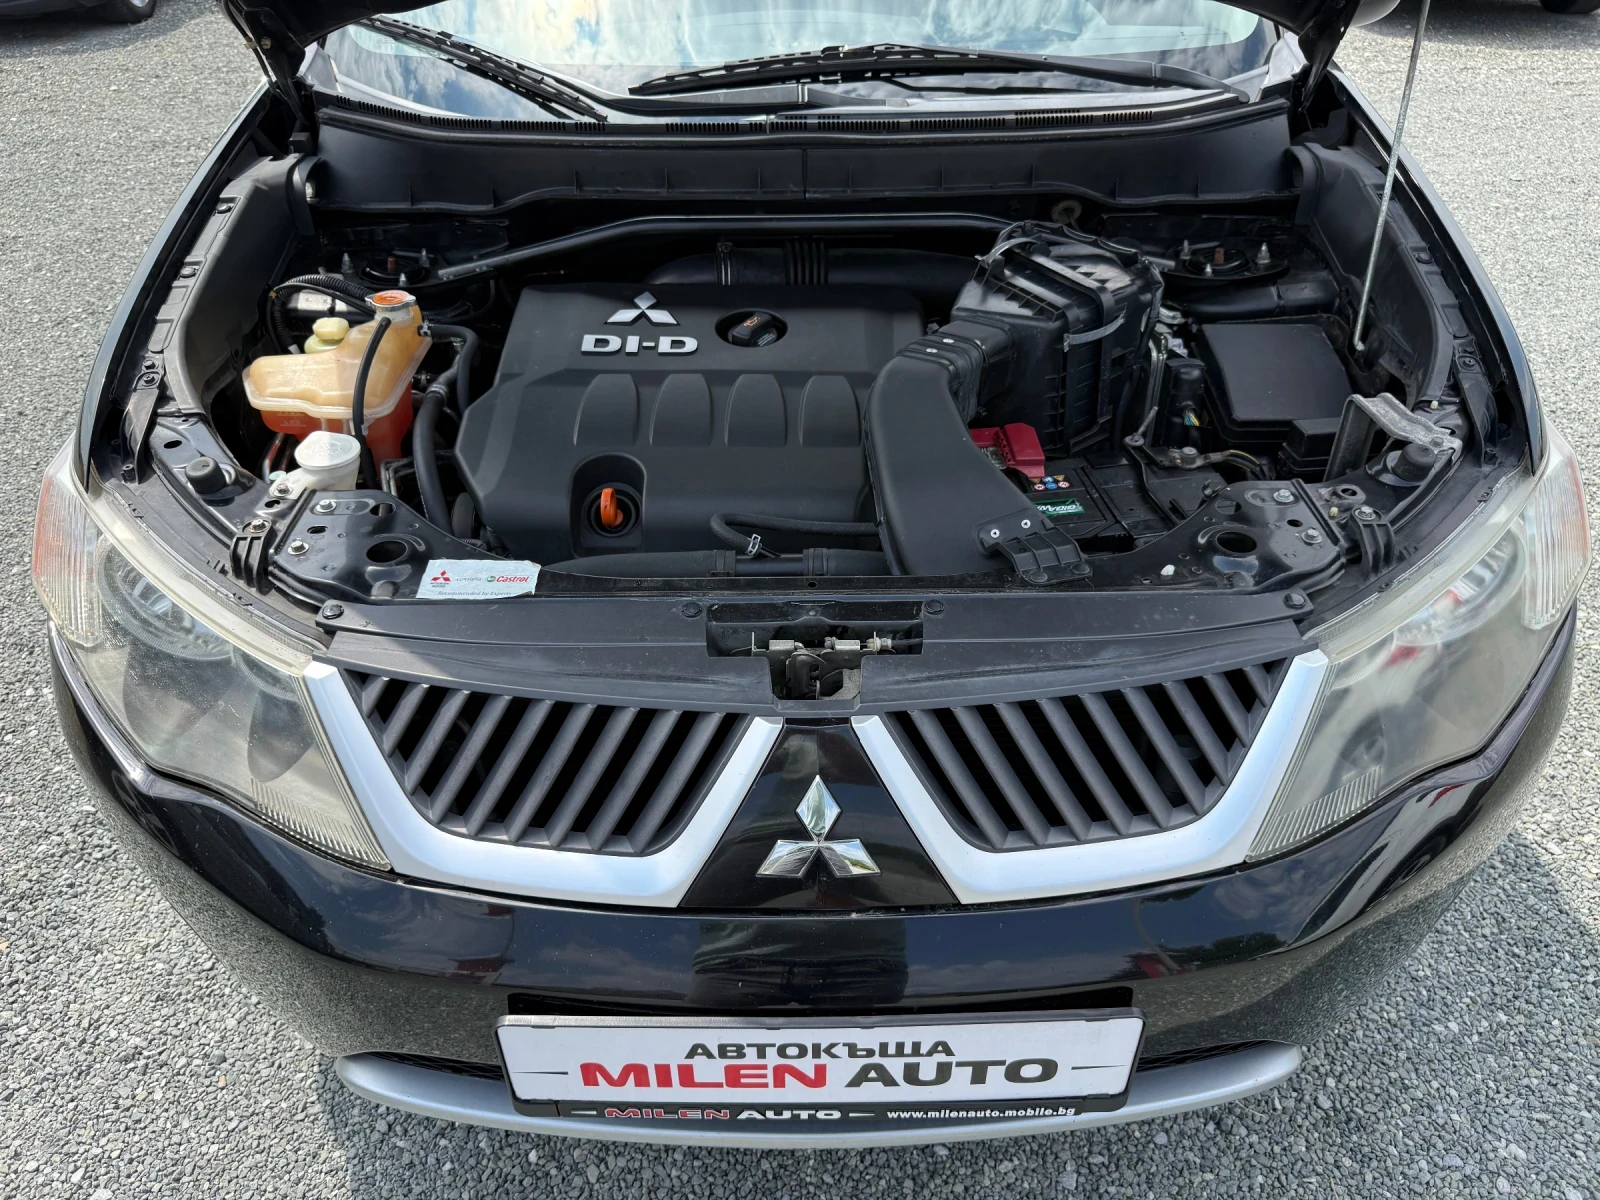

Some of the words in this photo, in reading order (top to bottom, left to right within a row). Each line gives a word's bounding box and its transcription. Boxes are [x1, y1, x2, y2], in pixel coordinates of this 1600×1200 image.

[580, 334, 699, 355] DI-D
[496, 575, 530, 583] Castrol
[580, 1062, 827, 1089] MILEN
[844, 1057, 1059, 1088] AUTO
[604, 1107, 730, 1119] MILEN
[736, 1110, 842, 1120] AUTO
[886, 1106, 1076, 1118] www.milenauto.mobile.bg
